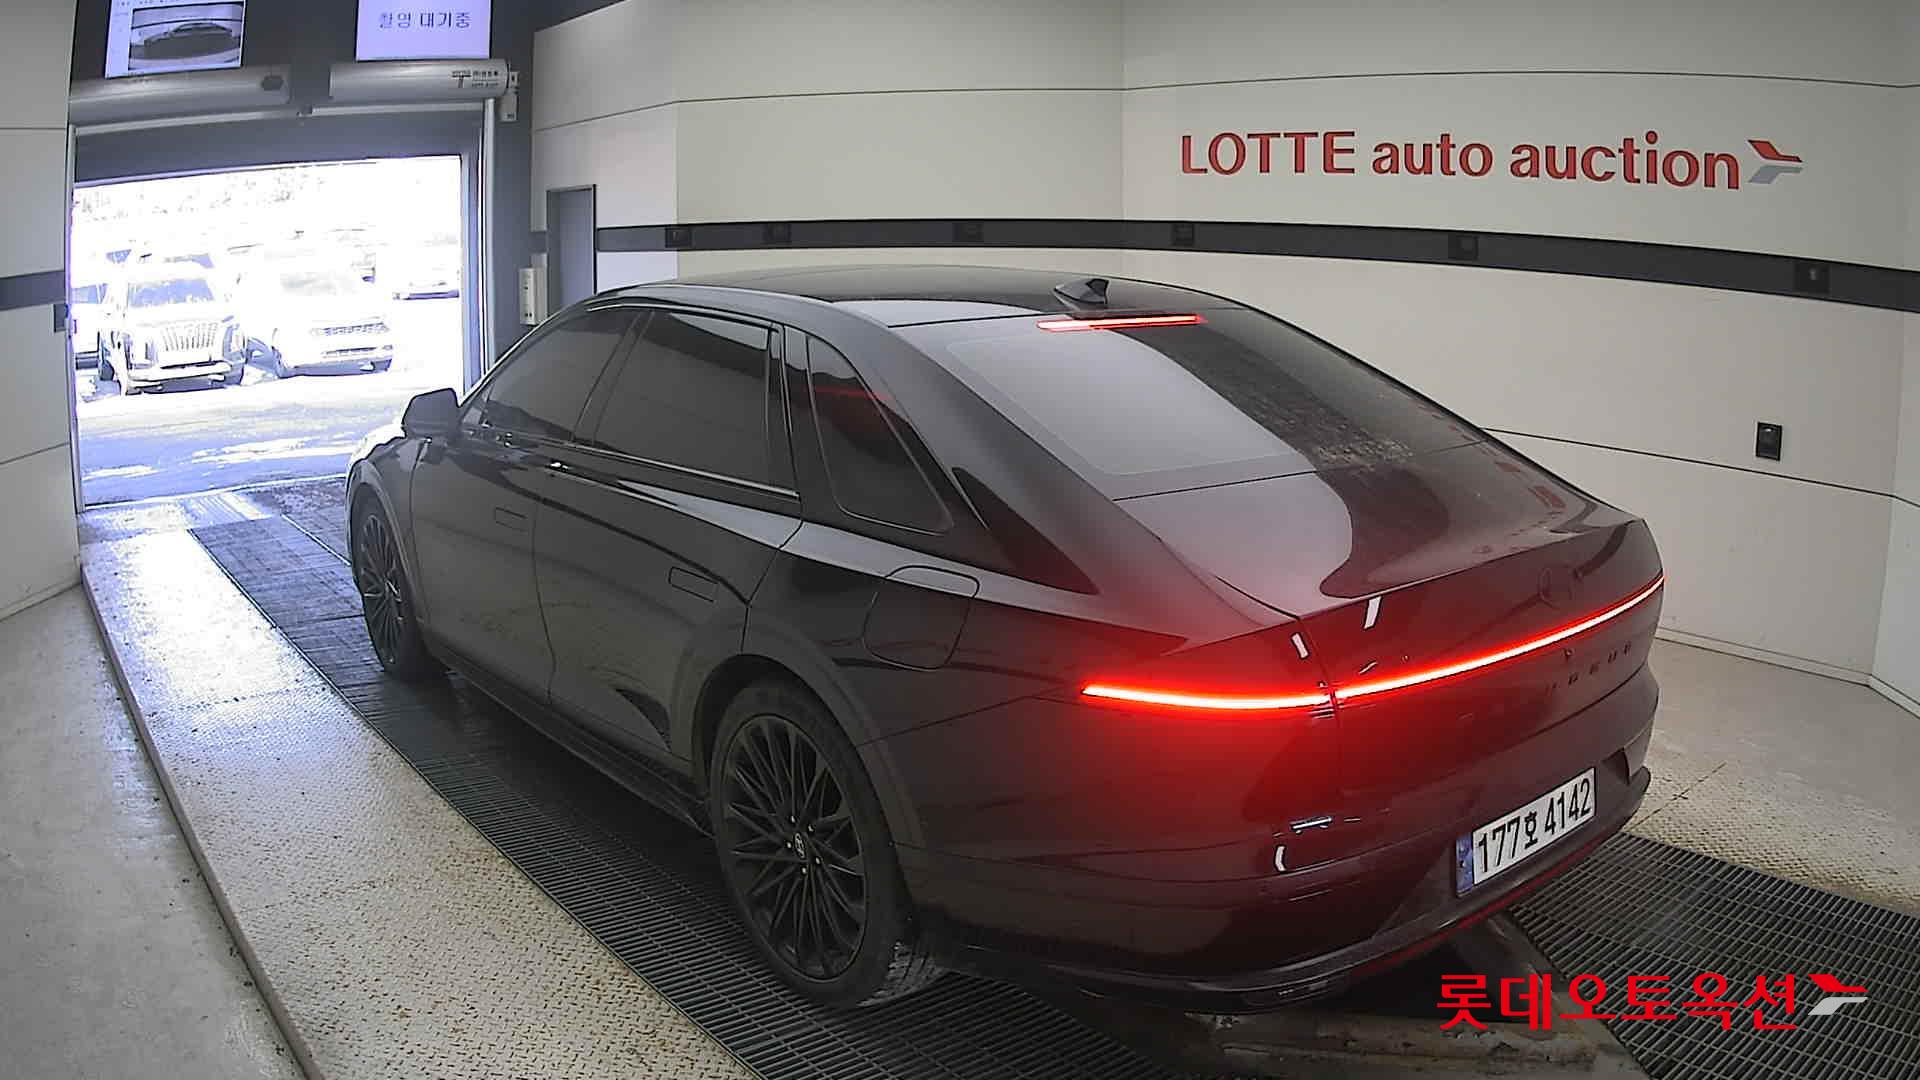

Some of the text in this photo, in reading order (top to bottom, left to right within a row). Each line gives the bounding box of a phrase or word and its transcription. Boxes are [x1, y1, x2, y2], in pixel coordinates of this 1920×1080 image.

[420, 11, 471, 29] 대기중
[1181, 130, 1741, 189] LOTTE auto auction
[1478, 778, 1591, 873] 177호 4142
